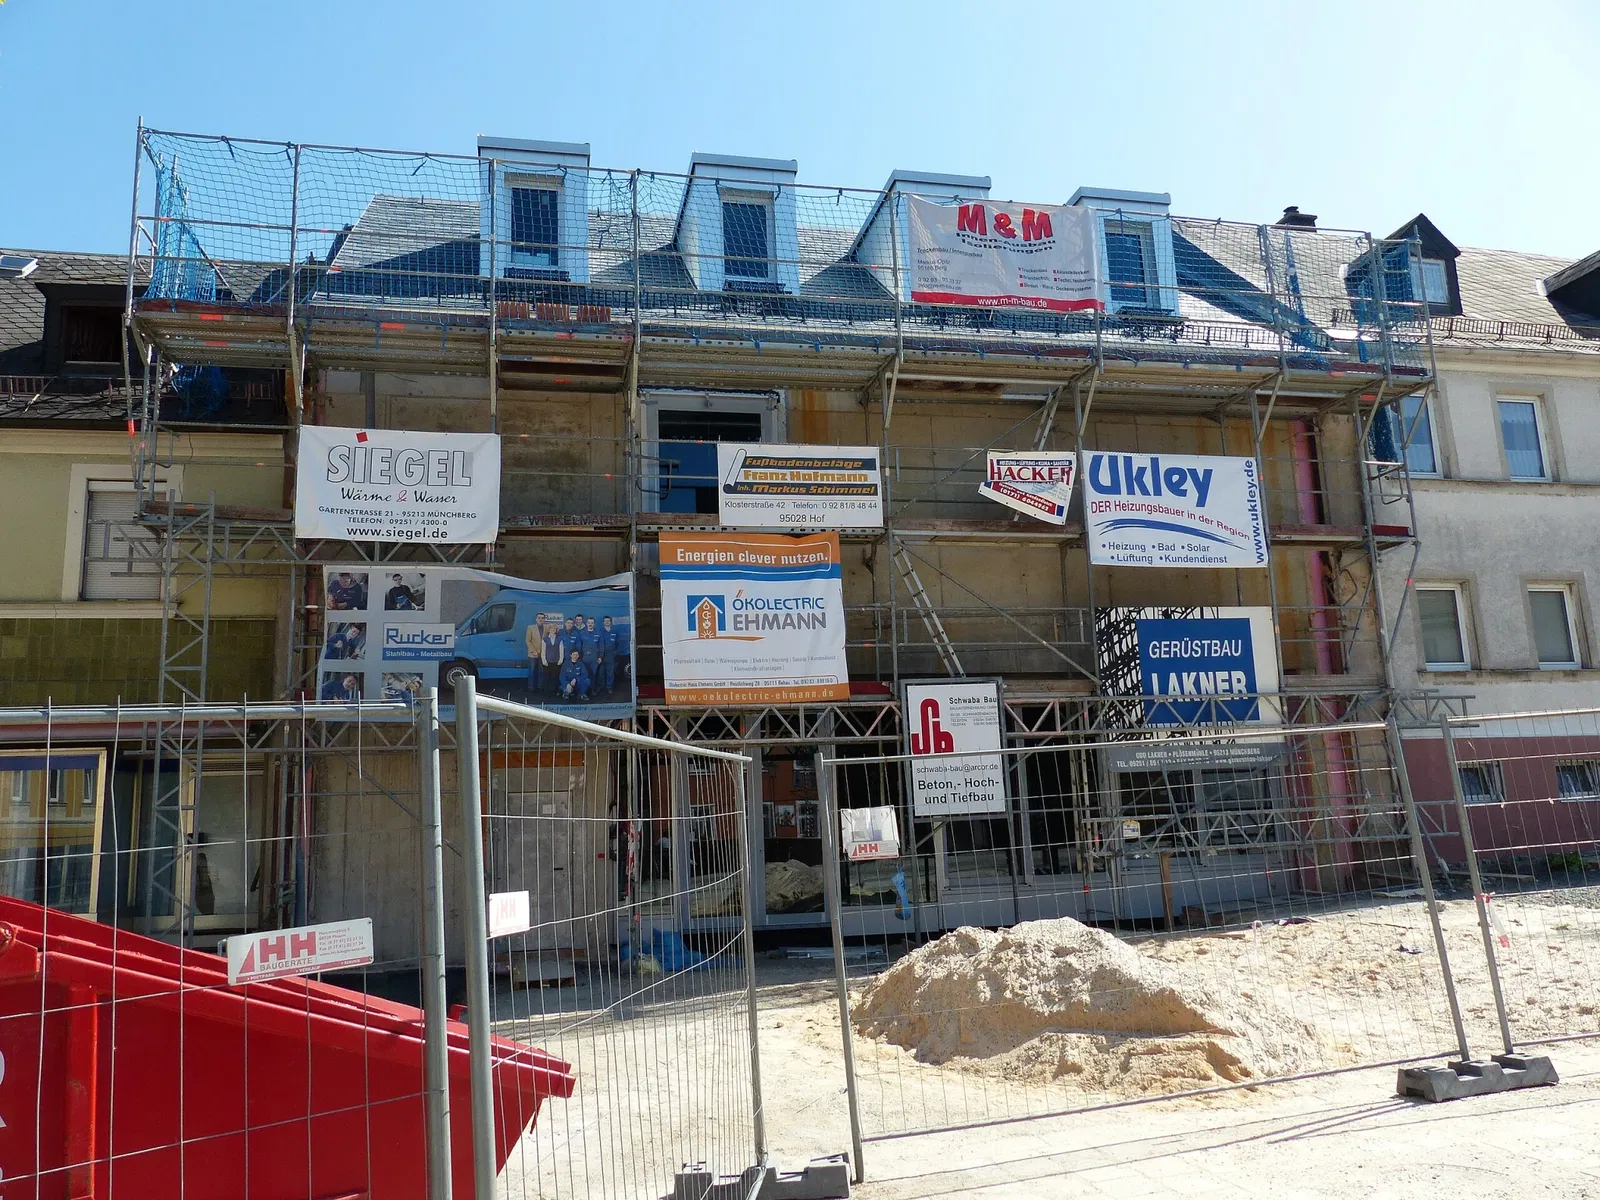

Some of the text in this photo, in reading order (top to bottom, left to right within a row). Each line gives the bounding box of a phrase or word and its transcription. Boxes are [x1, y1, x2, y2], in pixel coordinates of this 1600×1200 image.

[957, 204, 1054, 242] M & M
[956, 232, 1056, 249] Innen-Ausbau
[961, 238, 1053, 255] Isolierungen
[977, 297, 1047, 308] www.m-m-bau.de
[326, 444, 472, 487] SIEGEL
[745, 457, 863, 469] Fußbodenbeläge
[743, 470, 868, 482] Franz Hofmann
[1089, 454, 1213, 508] Ukley
[341, 487, 458, 504] Wärme & Wasser
[737, 484, 875, 494] Inh. Markus Schimmel
[318, 505, 383, 517] GARTENSTRASSE
[401, 510, 426, 518] 95213
[427, 510, 477, 519] MÜNCHBERG
[725, 501, 774, 509] Klosterstraße
[856, 502, 866, 510] 48
[867, 502, 877, 510] 44
[1243, 459, 1265, 564] www.ukley.de
[347, 516, 385, 524] TELEFON:
[389, 517, 413, 525] 09251
[420, 518, 448, 526] 4300-0
[779, 514, 825, 523] 95028 Hof
[1091, 500, 1250, 541] DER Heizungsbauer in der Region
[346, 526, 448, 540] www.siegel.de
[1108, 541, 1210, 552] Heizung Bad Solar
[676, 548, 828, 564] Energien clever nutzen.
[1117, 553, 1228, 564] Lüftung Kundendienst
[732, 590, 825, 611] ÖKOLECTRIC
[733, 611, 827, 631] EHMANN
[386, 627, 453, 645] Rucker
[1149, 637, 1242, 659] GERÜSTBAU
[1151, 670, 1249, 703] LAKNER
[670, 689, 834, 702] www.oekolectric-ehmann.de
[948, 695, 997, 705] Schwaba Bau
[916, 764, 999, 774] schwaba-bau@arcor.de
[918, 777, 1000, 790] Beton,- Hoch-
[924, 792, 995, 804] und Tiefbau
[858, 843, 878, 853] HH
[259, 931, 317, 964] HH
[260, 957, 312, 972] BAUGERÄTE
